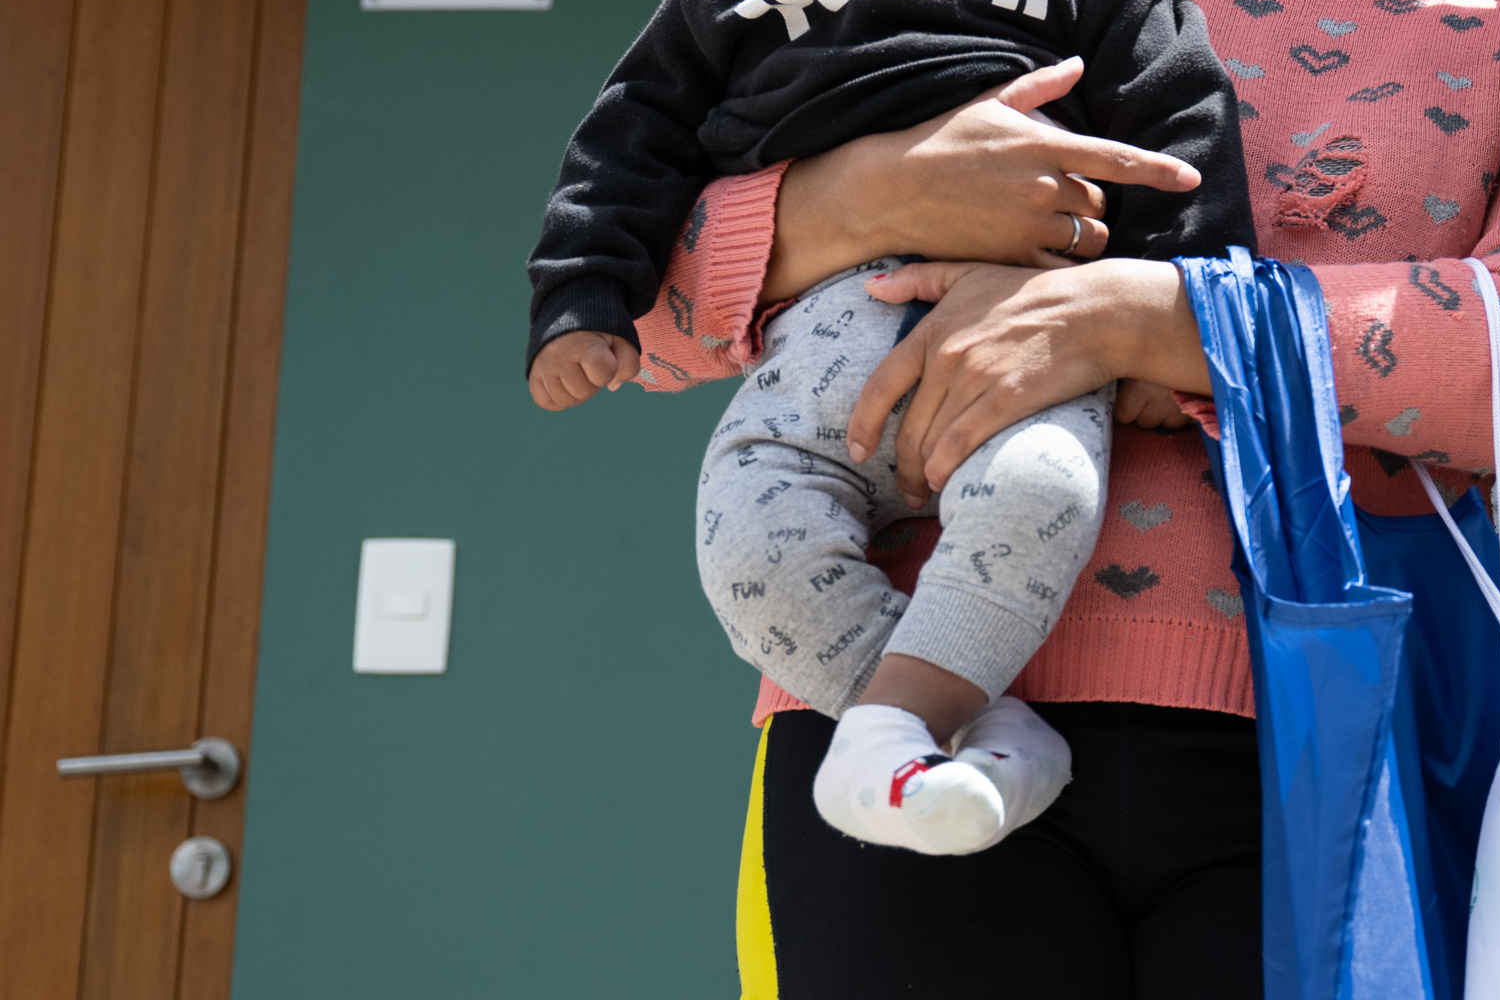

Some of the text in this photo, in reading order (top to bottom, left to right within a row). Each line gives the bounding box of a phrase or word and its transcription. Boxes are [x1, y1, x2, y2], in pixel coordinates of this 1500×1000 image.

[757, 368, 781, 390] FUN
[811, 354, 851, 398] HAPPY
[755, 480, 793, 506] FUN
[961, 482, 996, 500] FUN
[768, 526, 807, 543] enjoy
[1036, 502, 1081, 543] HAPPY
[810, 563, 847, 593] FUN
[970, 551, 993, 584] enjoy
[732, 581, 766, 601] FUN
[768, 625, 798, 656] enjoy
[816, 623, 865, 666] HAPPY
